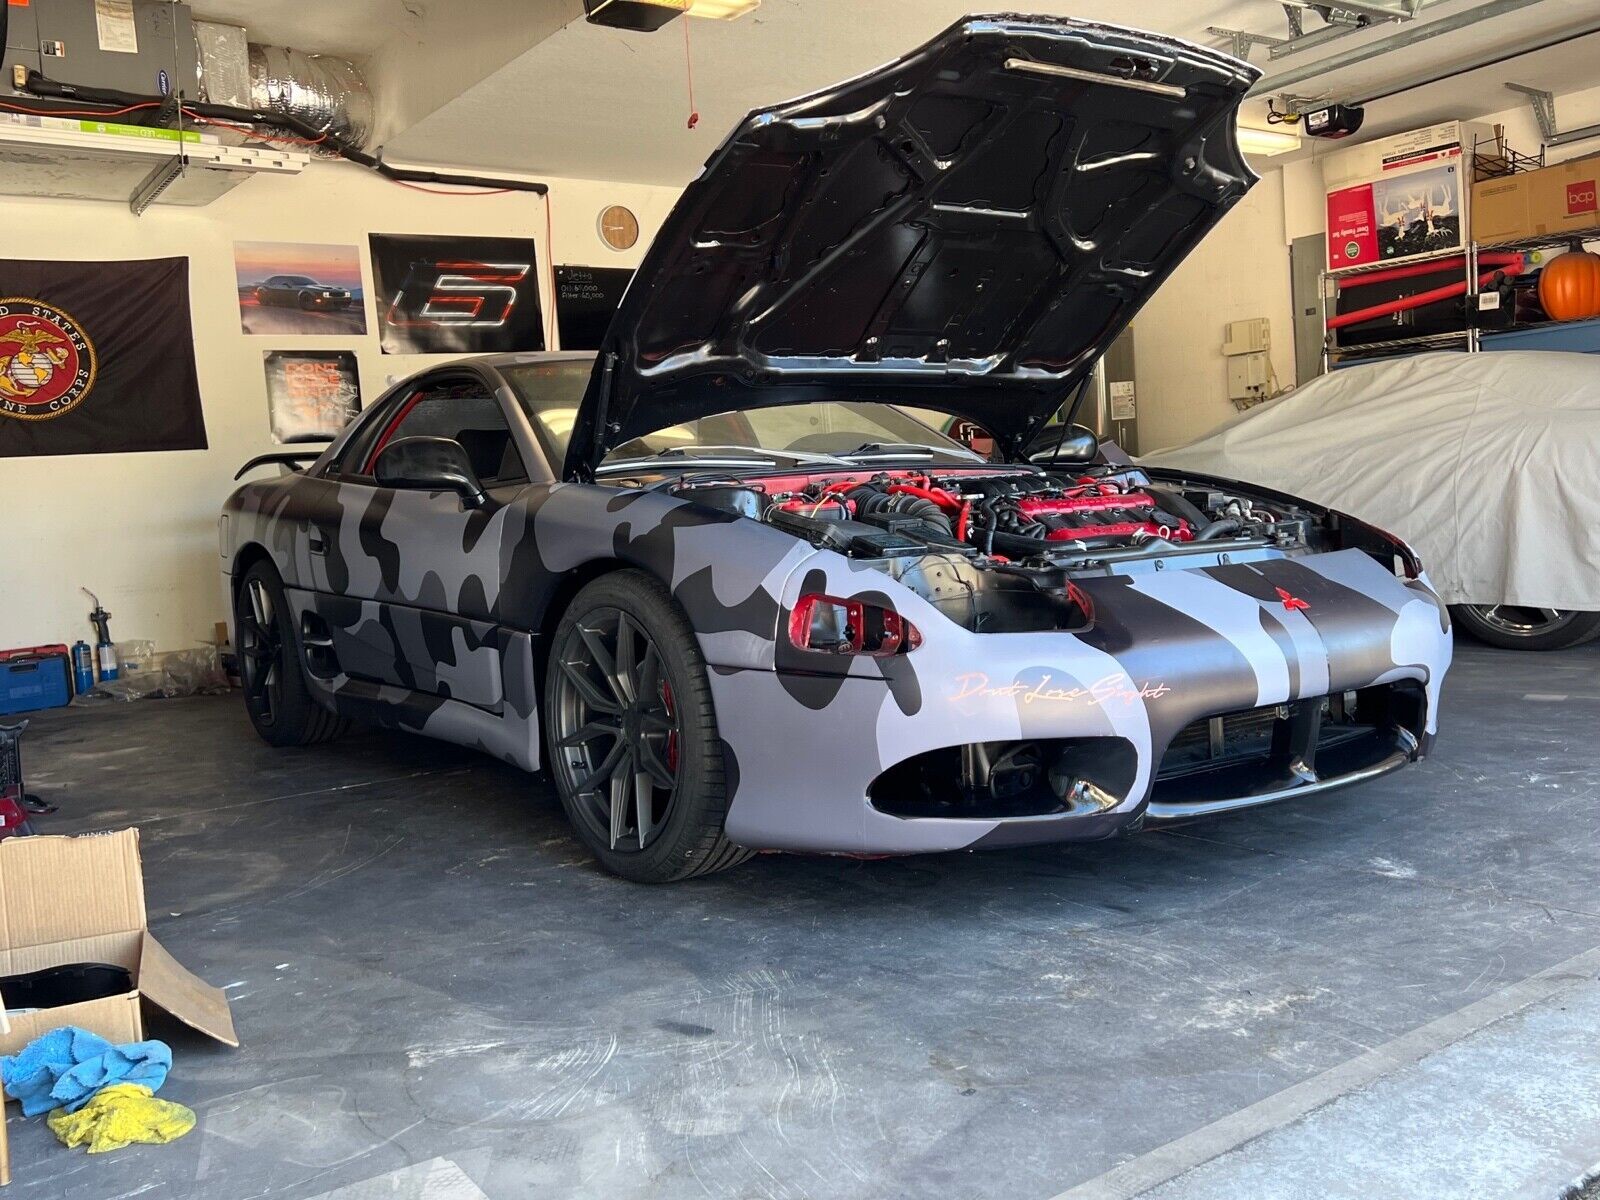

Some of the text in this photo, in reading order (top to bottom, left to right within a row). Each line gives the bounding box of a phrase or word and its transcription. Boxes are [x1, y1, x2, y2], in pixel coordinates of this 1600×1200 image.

[1568, 191, 1594, 205] bcp
[32, 306, 87, 351] STATES
[49, 369, 89, 411] CORPS
[1025, 674, 1088, 704] Lose
[1087, 672, 1171, 705] Sight
